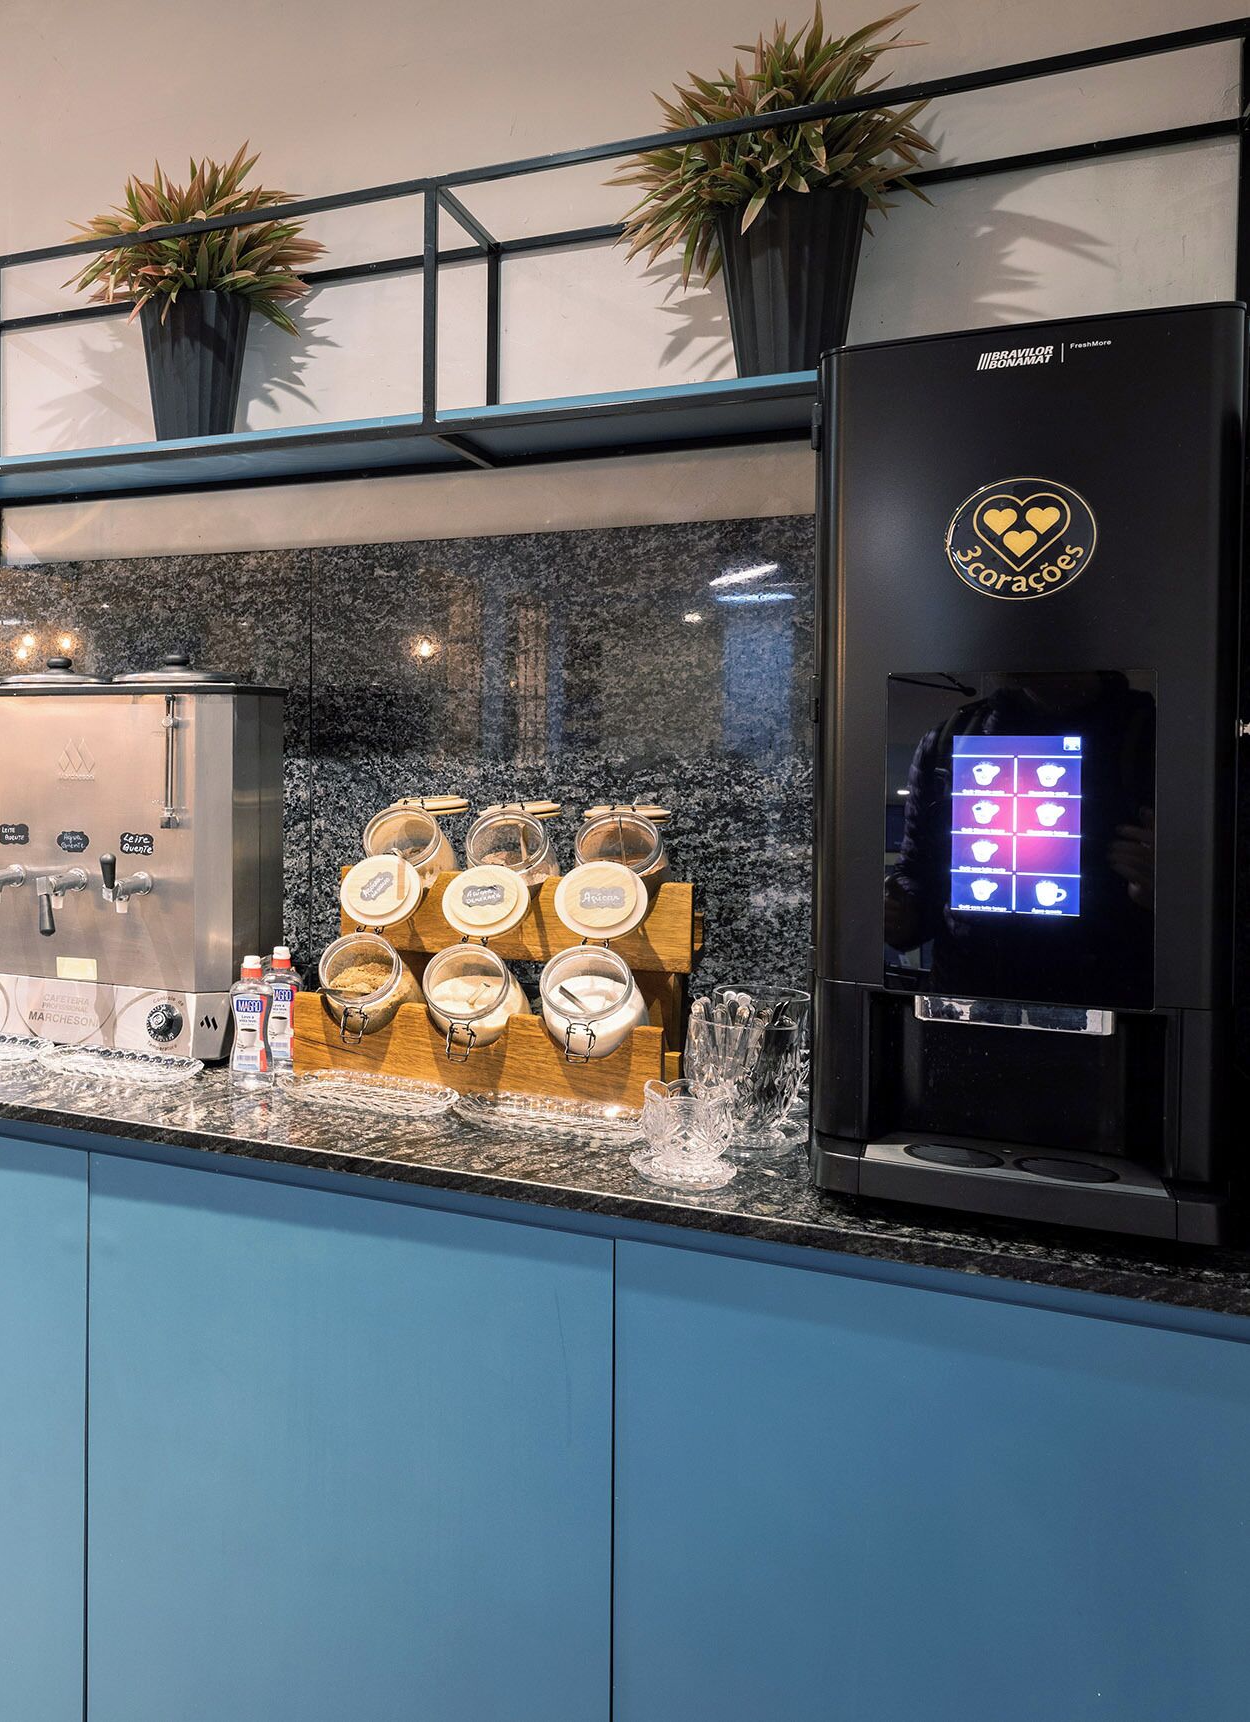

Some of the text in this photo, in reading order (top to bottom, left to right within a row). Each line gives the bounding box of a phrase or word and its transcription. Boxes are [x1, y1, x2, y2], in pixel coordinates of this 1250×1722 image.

[1070, 340, 1112, 349] FreshMore
[991, 345, 1054, 360] BRAVILOR
[988, 354, 1053, 370] BONAMAT
[956, 544, 1084, 593] 3 corações
[237, 1001, 261, 1012] MAGRO
